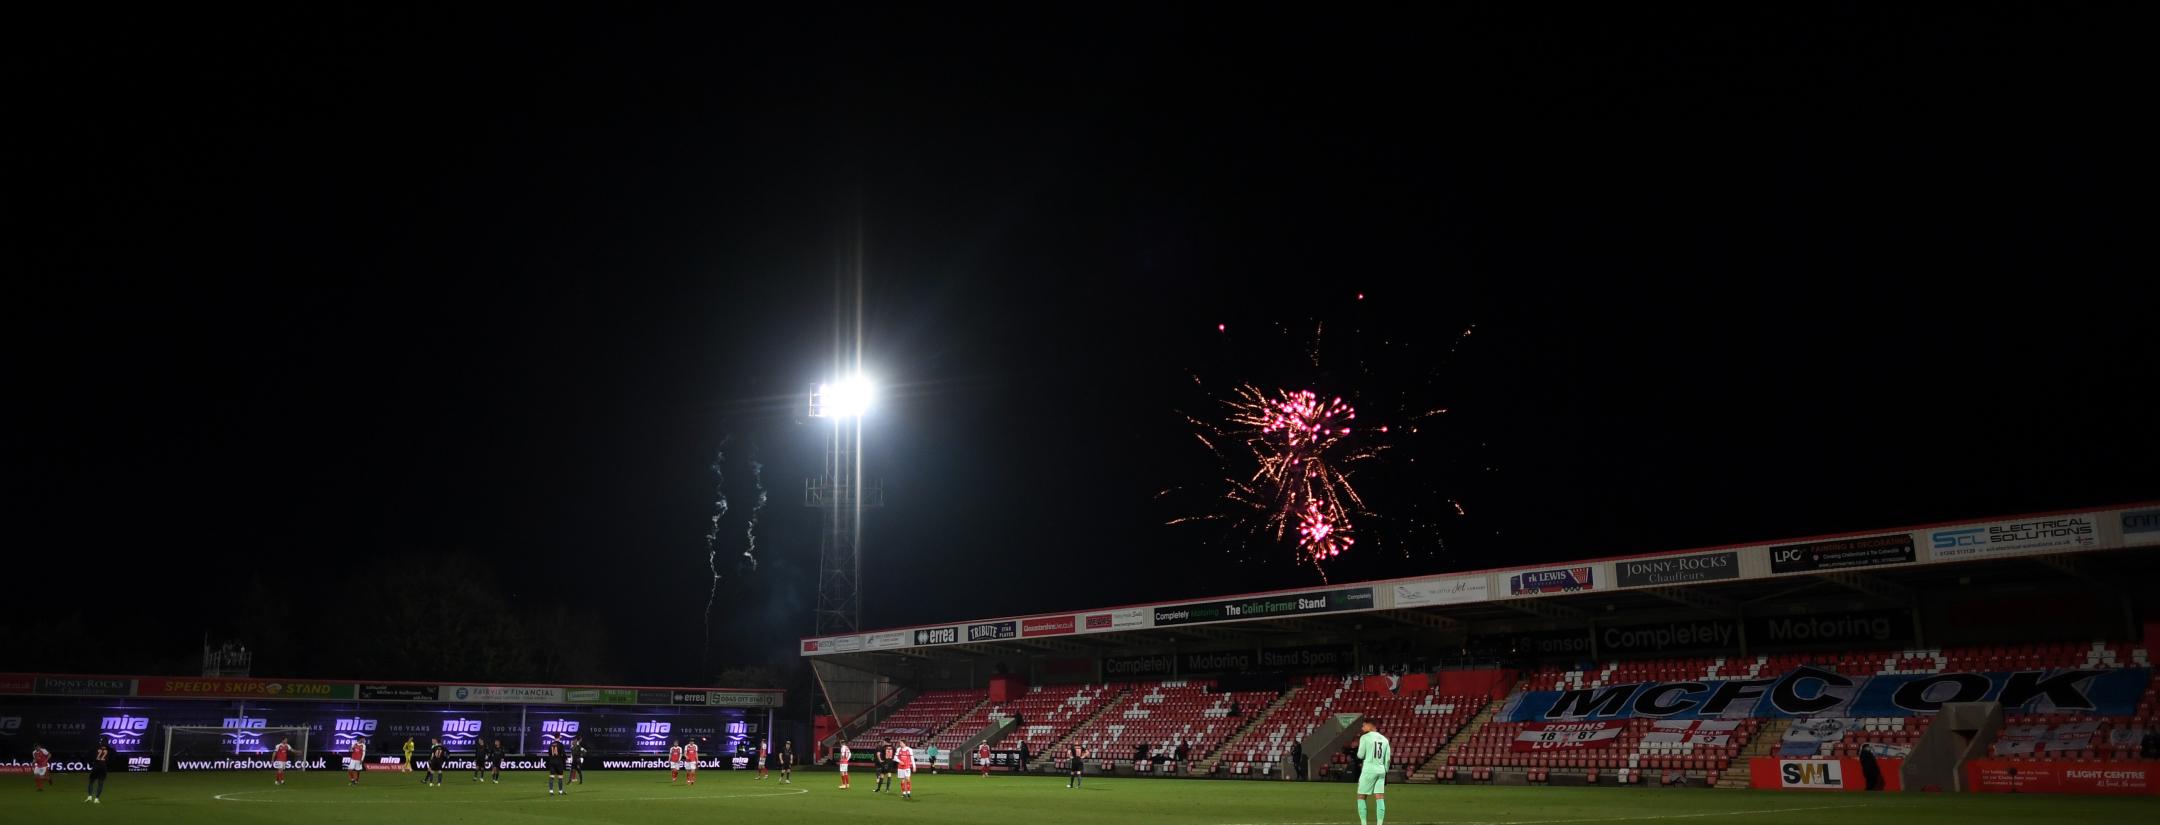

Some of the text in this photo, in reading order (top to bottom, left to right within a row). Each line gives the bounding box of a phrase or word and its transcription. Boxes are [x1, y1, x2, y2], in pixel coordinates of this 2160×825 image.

[1988, 518, 2091, 535] ELECTRICAL
[1932, 528, 1987, 549] SCL
[1989, 526, 2093, 543] SOLUTIONS
[1627, 556, 1728, 577] JONNY-ROCKS
[1539, 570, 1566, 582] LEWIS
[1649, 571, 1705, 584] Chauffeurs
[1155, 610, 1190, 622] Completely
[1225, 604, 1241, 616] The
[1241, 602, 1263, 615] Colin
[1264, 600, 1297, 613] Farmer
[1298, 597, 1327, 610] Stand
[929, 627, 955, 645] errea
[970, 625, 998, 640] TRIBUTE
[1604, 613, 1890, 650] Completely Motoring
[1106, 653, 1249, 677] Completely Motoring
[1264, 650, 1299, 667] Stand
[165, 681, 331, 695] SPEEDY SKIPS STAND
[510, 688, 555, 697] FINANCIAL
[1545, 665, 2113, 720] MCFC OK
[684, 692, 706, 703] errea
[101, 714, 150, 730] mira
[222, 715, 267, 729] mira
[335, 716, 378, 731] mira
[442, 717, 482, 732] mira
[542, 718, 580, 733] mira
[636, 719, 672, 734] mira
[725, 720, 759, 734] mira
[1543, 721, 1607, 732] ROBINS
[1541, 731, 1597, 741] 18 87
[96, 750, 108, 761] 22
[1374, 741, 1383, 759] 13
[128, 756, 151, 765] mira
[177, 757, 326, 769] www.mirashowes.co.uk
[380, 756, 400, 764] mira
[1782, 763, 1842, 785] SWL
[2066, 770, 2145, 780] FLIGHT CENTRE
